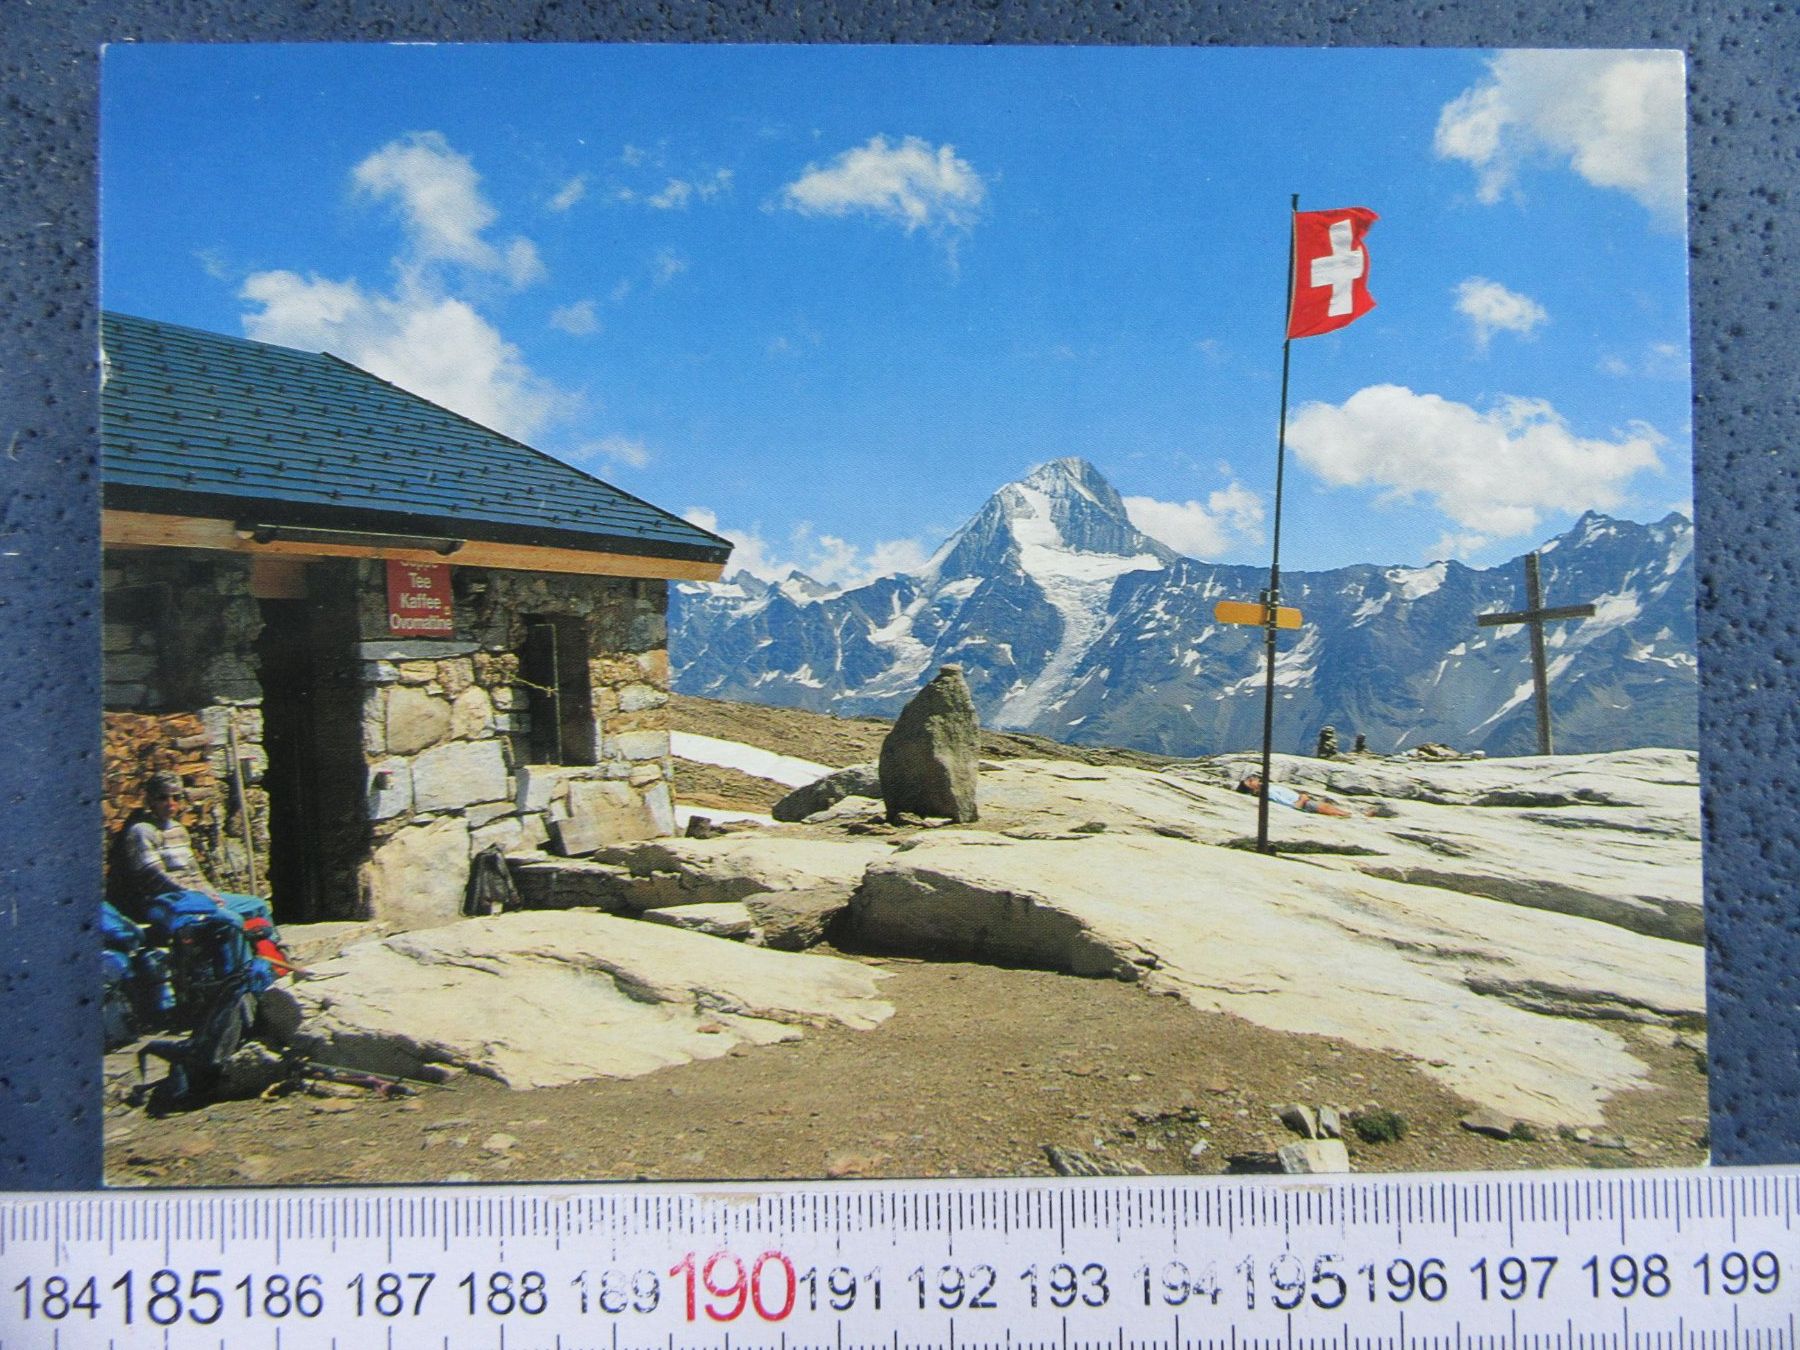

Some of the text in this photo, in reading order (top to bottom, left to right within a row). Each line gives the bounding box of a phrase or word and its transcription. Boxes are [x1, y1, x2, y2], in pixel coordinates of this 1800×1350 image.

[408, 572, 432, 589] Tee
[400, 593, 441, 609] Kaffee
[13, 1250, 1781, 1326] 184 185 186 187 188 189 190 191 192 193 194 195 196 197 198 199
